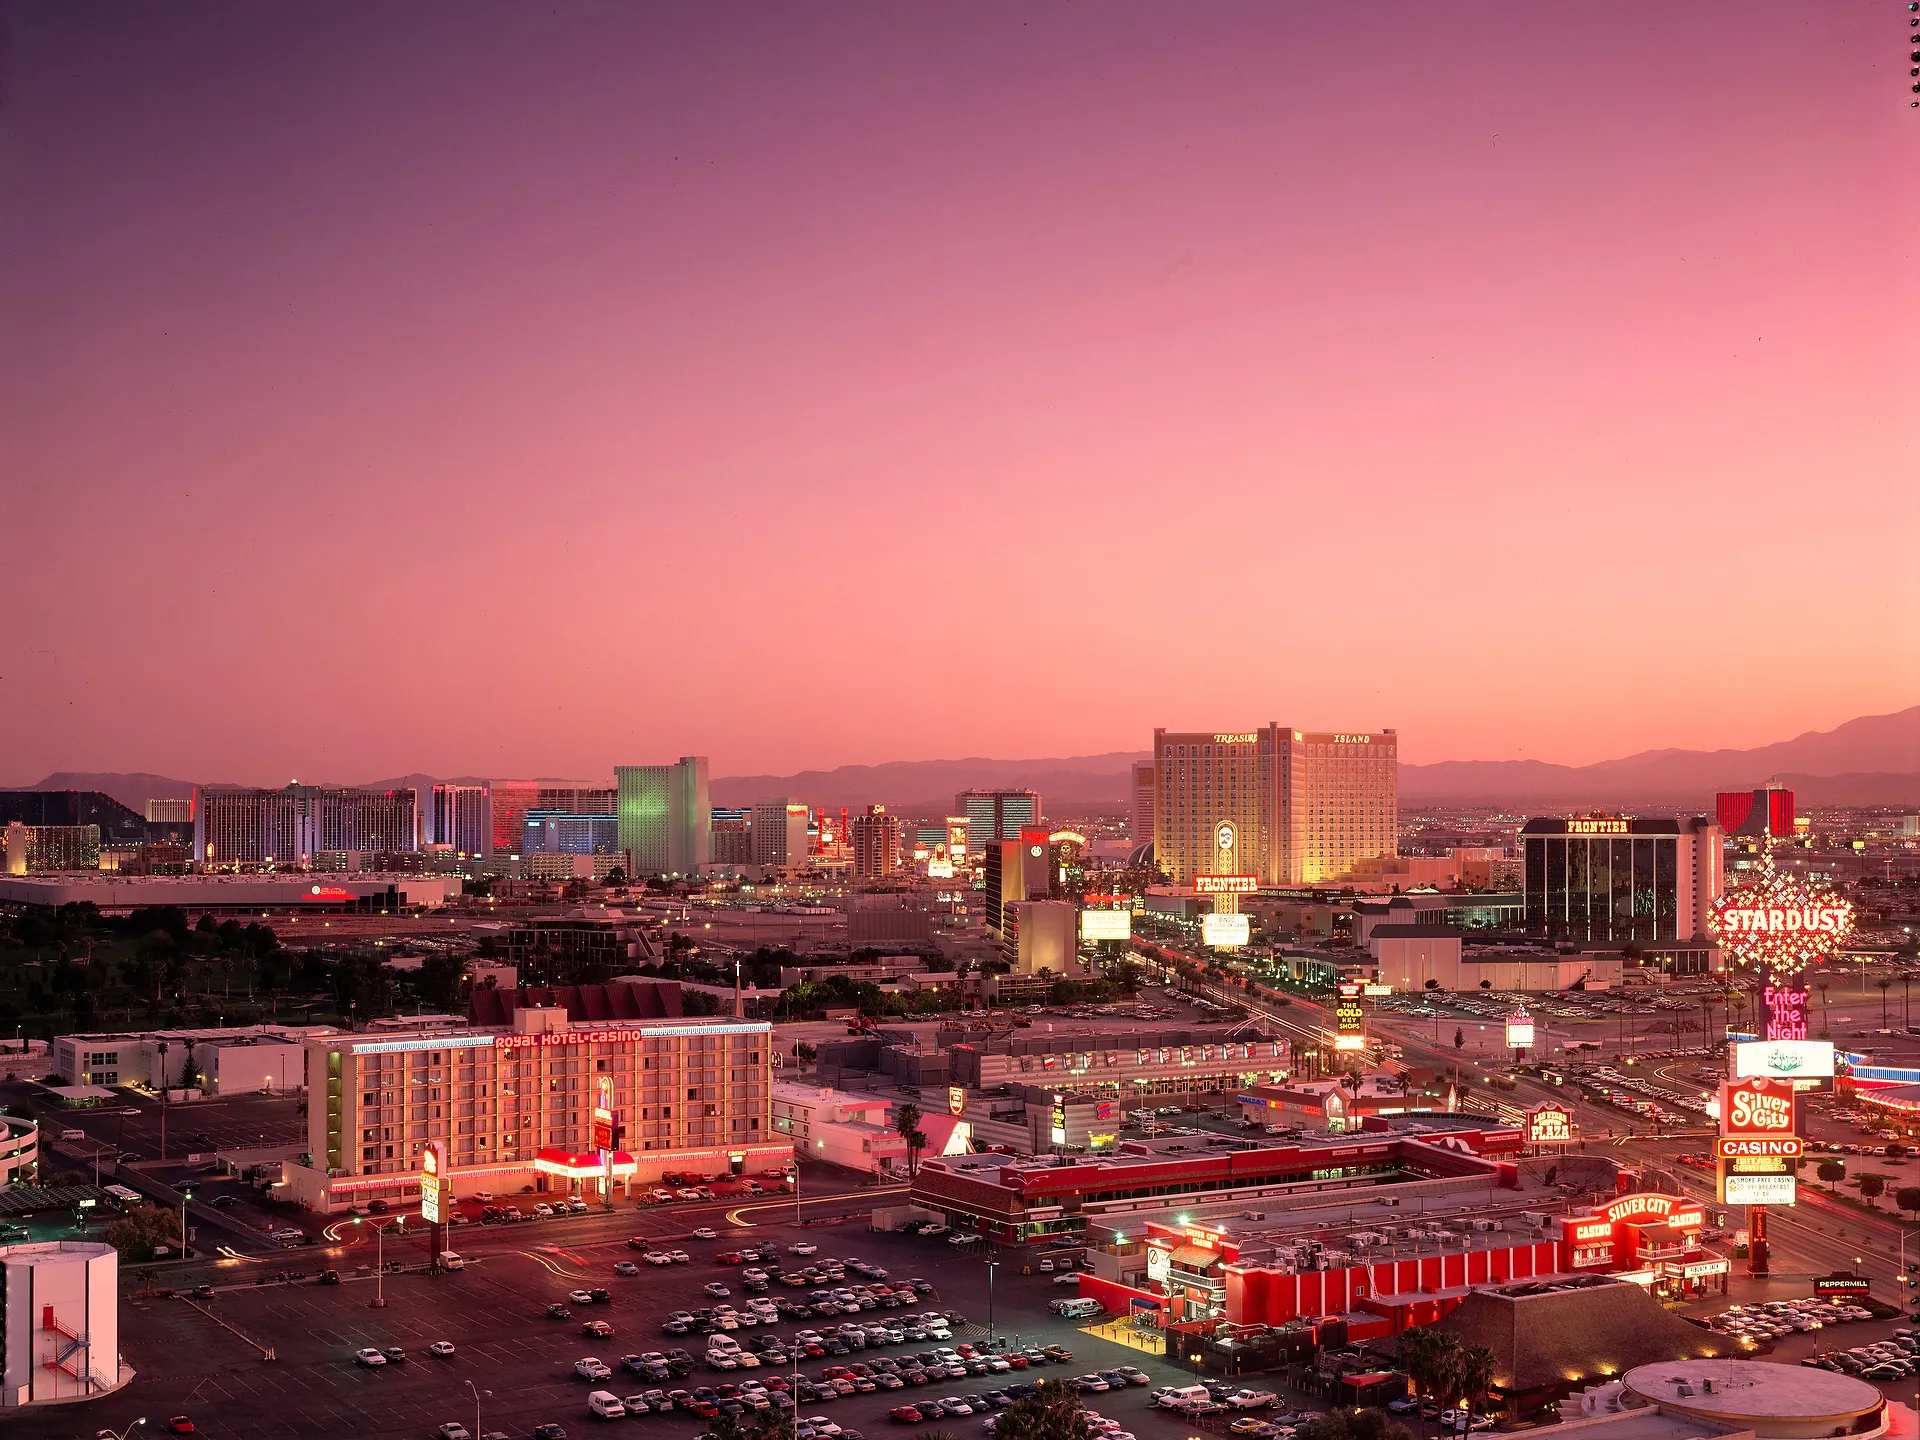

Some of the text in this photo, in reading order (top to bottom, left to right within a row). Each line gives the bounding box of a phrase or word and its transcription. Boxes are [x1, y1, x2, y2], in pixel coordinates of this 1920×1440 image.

[1213, 734, 1258, 744] TREASURE
[1333, 735, 1370, 743] ISLAND
[1567, 821, 1628, 833] FRONTIER
[1196, 877, 1258, 892] FRONTIER
[1723, 908, 1850, 932] STARDUST
[1764, 986, 1808, 1006] Enter
[1336, 1008, 1363, 1018] GOLD
[1773, 1005, 1801, 1023] the
[1766, 1022, 1808, 1042] Night
[495, 1036, 538, 1049] ROYAL
[541, 1033, 584, 1046] HOTEL
[1731, 1090, 1791, 1127] Silver
[1533, 1111, 1547, 1124] LAS
[1752, 1109, 1790, 1130] City
[1531, 1125, 1570, 1140] PLAZA
[1723, 1140, 1798, 1155] CASINO
[1608, 1197, 1673, 1222] SILVER CITY
[1668, 1212, 1702, 1228] CASINO
[1186, 1228, 1219, 1242] SILVER CITY
[1576, 1223, 1611, 1240] CASINO
[1192, 1237, 1213, 1249] CASINO
[1819, 1280, 1868, 1288] PEPPERMILL
